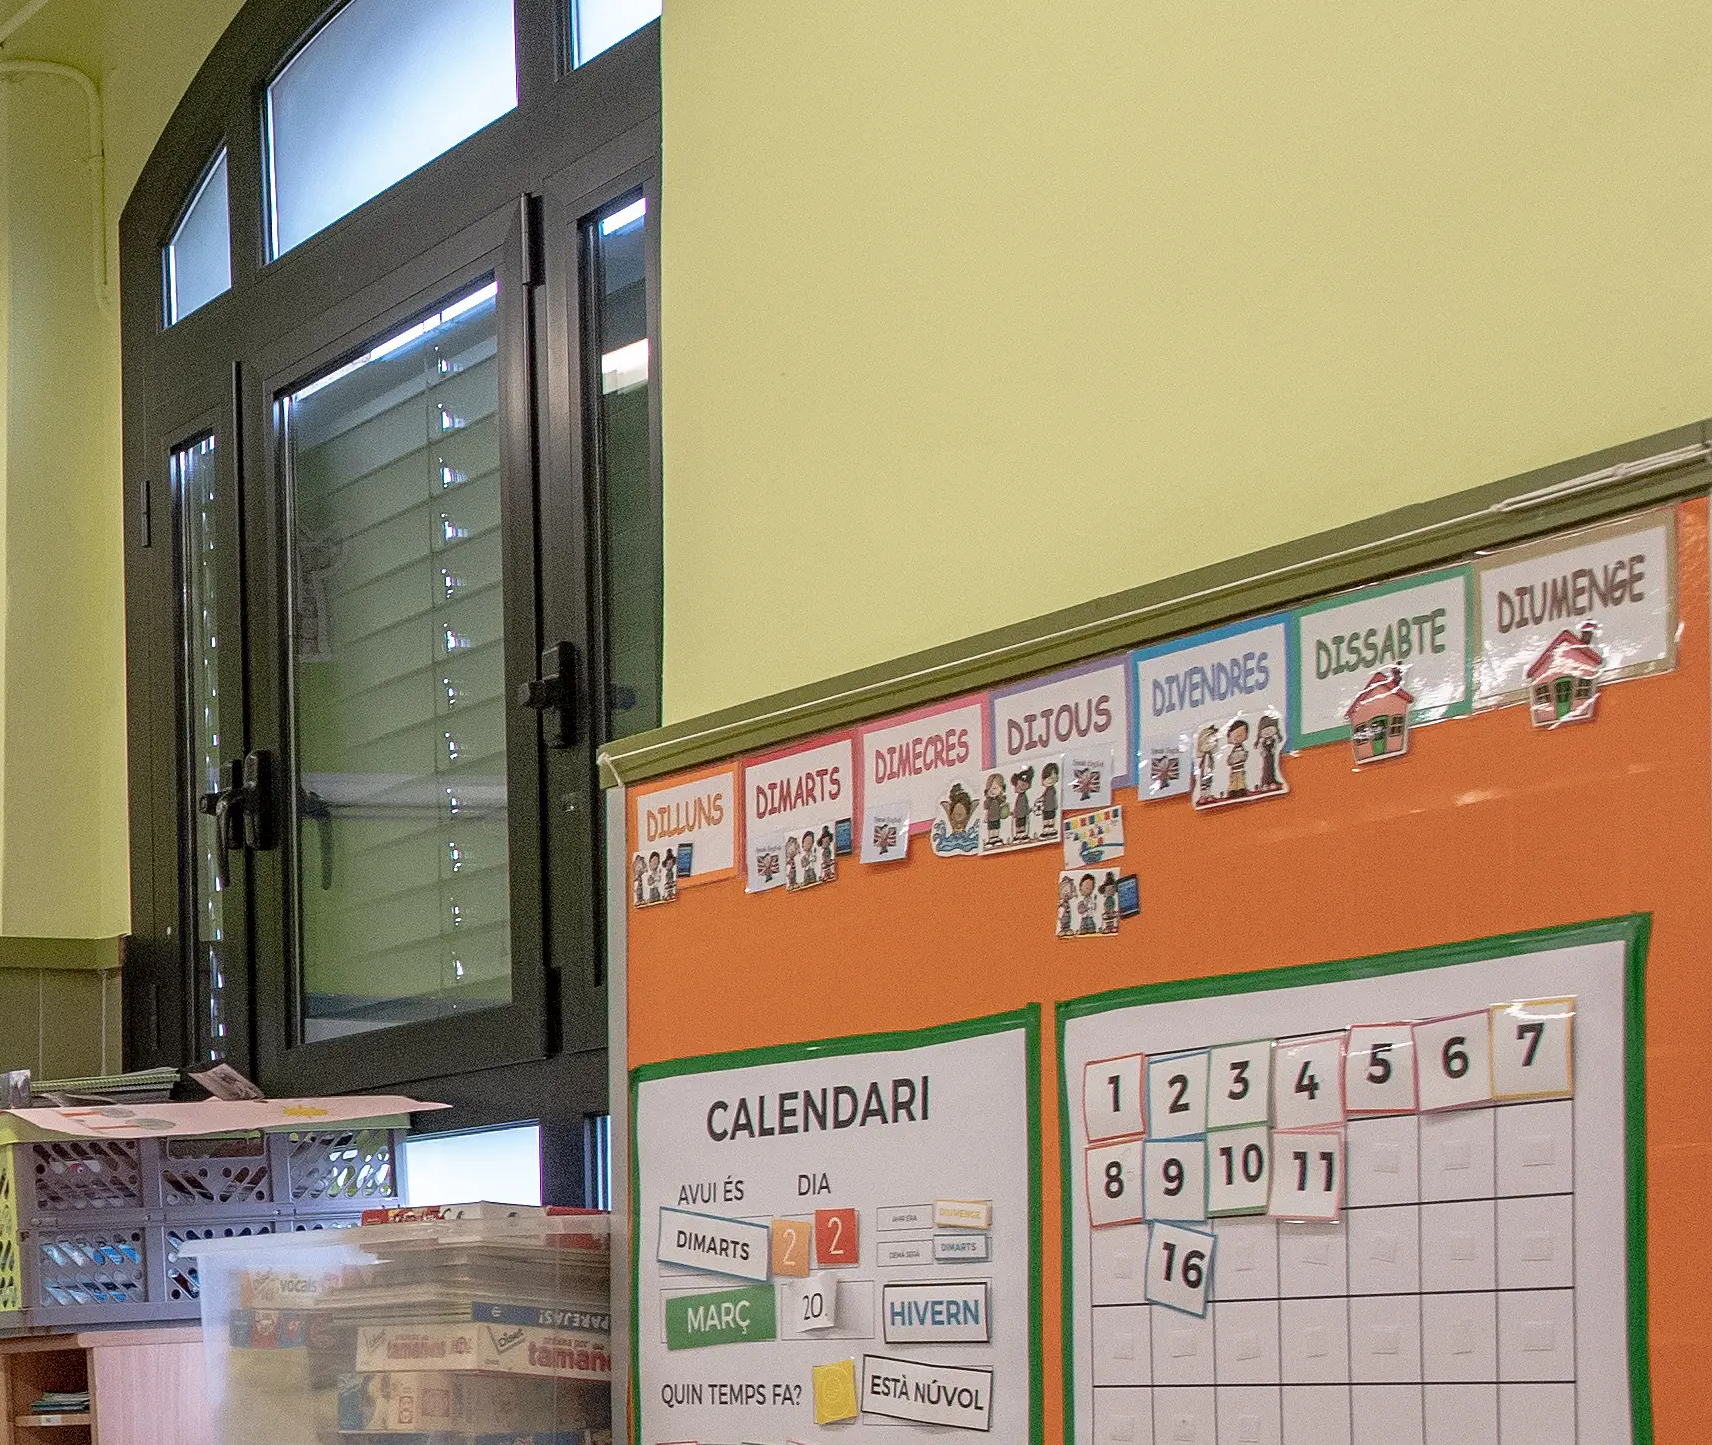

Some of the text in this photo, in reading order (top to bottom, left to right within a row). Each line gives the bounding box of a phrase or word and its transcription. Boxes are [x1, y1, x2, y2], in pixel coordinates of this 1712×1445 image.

[1496, 555, 1646, 633] DIUMENGE
[1315, 607, 1447, 681] DISSABTE
[1152, 650, 1272, 718] DIVENDRES
[1007, 695, 1112, 756] DIJOUS
[875, 728, 969, 784] DIMECRES
[756, 766, 841, 820] DIMARTS
[646, 793, 724, 842] DILLUNS
[1367, 1044, 1393, 1084] 5
[1442, 1036, 1469, 1079] 6
[1516, 1023, 1544, 1068] 7
[1107, 1076, 1122, 1112] 1
[1168, 1076, 1190, 1114] 2
[1228, 1061, 1251, 1100] 3
[1294, 1062, 1319, 1101] 4
[706, 1075, 930, 1142] CALENDARI
[1105, 1160, 1125, 1200] 8
[1162, 1158, 1186, 1197] 9
[1218, 1143, 1264, 1185] 10
[1292, 1151, 1335, 1192] 11
[677, 1175, 745, 1206] AVUI ÉS
[797, 1173, 832, 1197] DIA
[676, 1230, 750, 1261] DIMARTS
[782, 1217, 843, 1266] 2 2
[1161, 1241, 1206, 1290] 16
[687, 1300, 751, 1334] MARÇ
[889, 1299, 981, 1329] HIVERN
[661, 1382, 803, 1407] QUIN TEMPS FA?
[871, 1370, 984, 1411] ESTÀ NÚVOL
